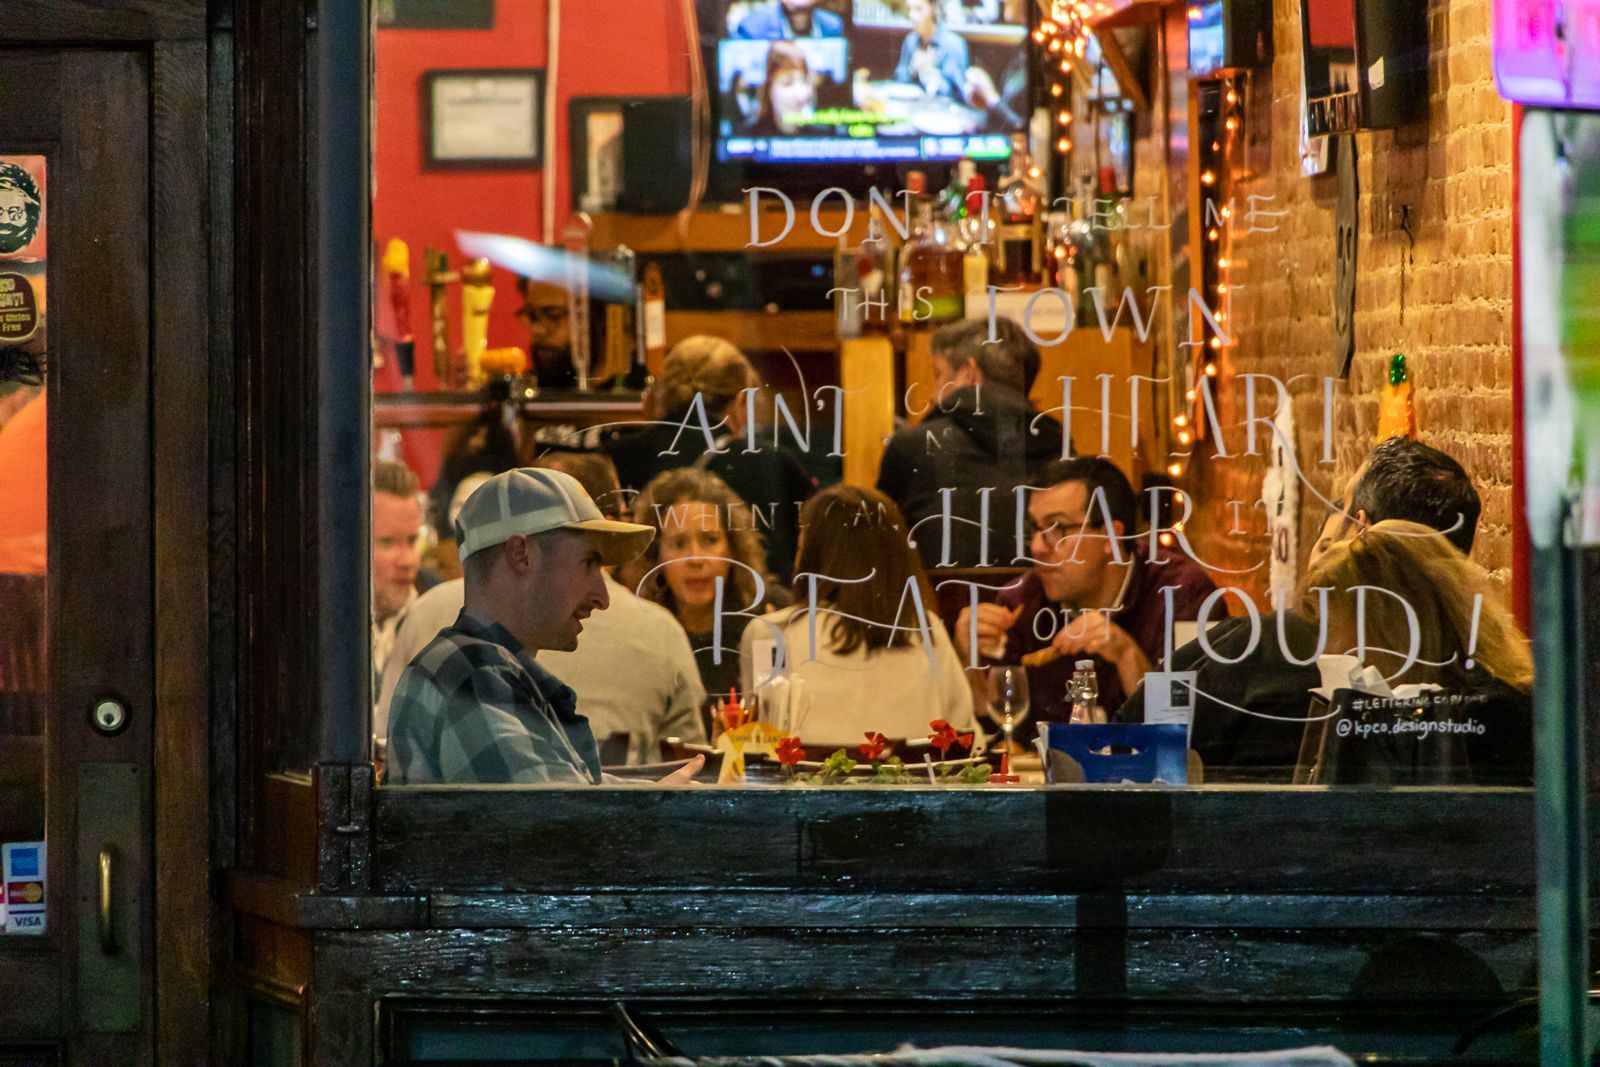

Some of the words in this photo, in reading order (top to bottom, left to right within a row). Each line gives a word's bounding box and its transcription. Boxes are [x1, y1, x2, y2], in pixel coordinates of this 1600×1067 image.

[1053, 195, 1172, 231] TELL
[1205, 194, 1290, 234] ME
[825, 286, 934, 321] THIS
[979, 284, 1245, 348] TOWN
[1030, 373, 1375, 490] HEART
[651, 502, 779, 532] WHEN
[907, 485, 1265, 574] HEAR
[636, 556, 1023, 696] BEAT
[1032, 604, 1124, 641] OUT
[1137, 584, 1484, 721] LOUD!
[14, 917, 42, 926] VISA
